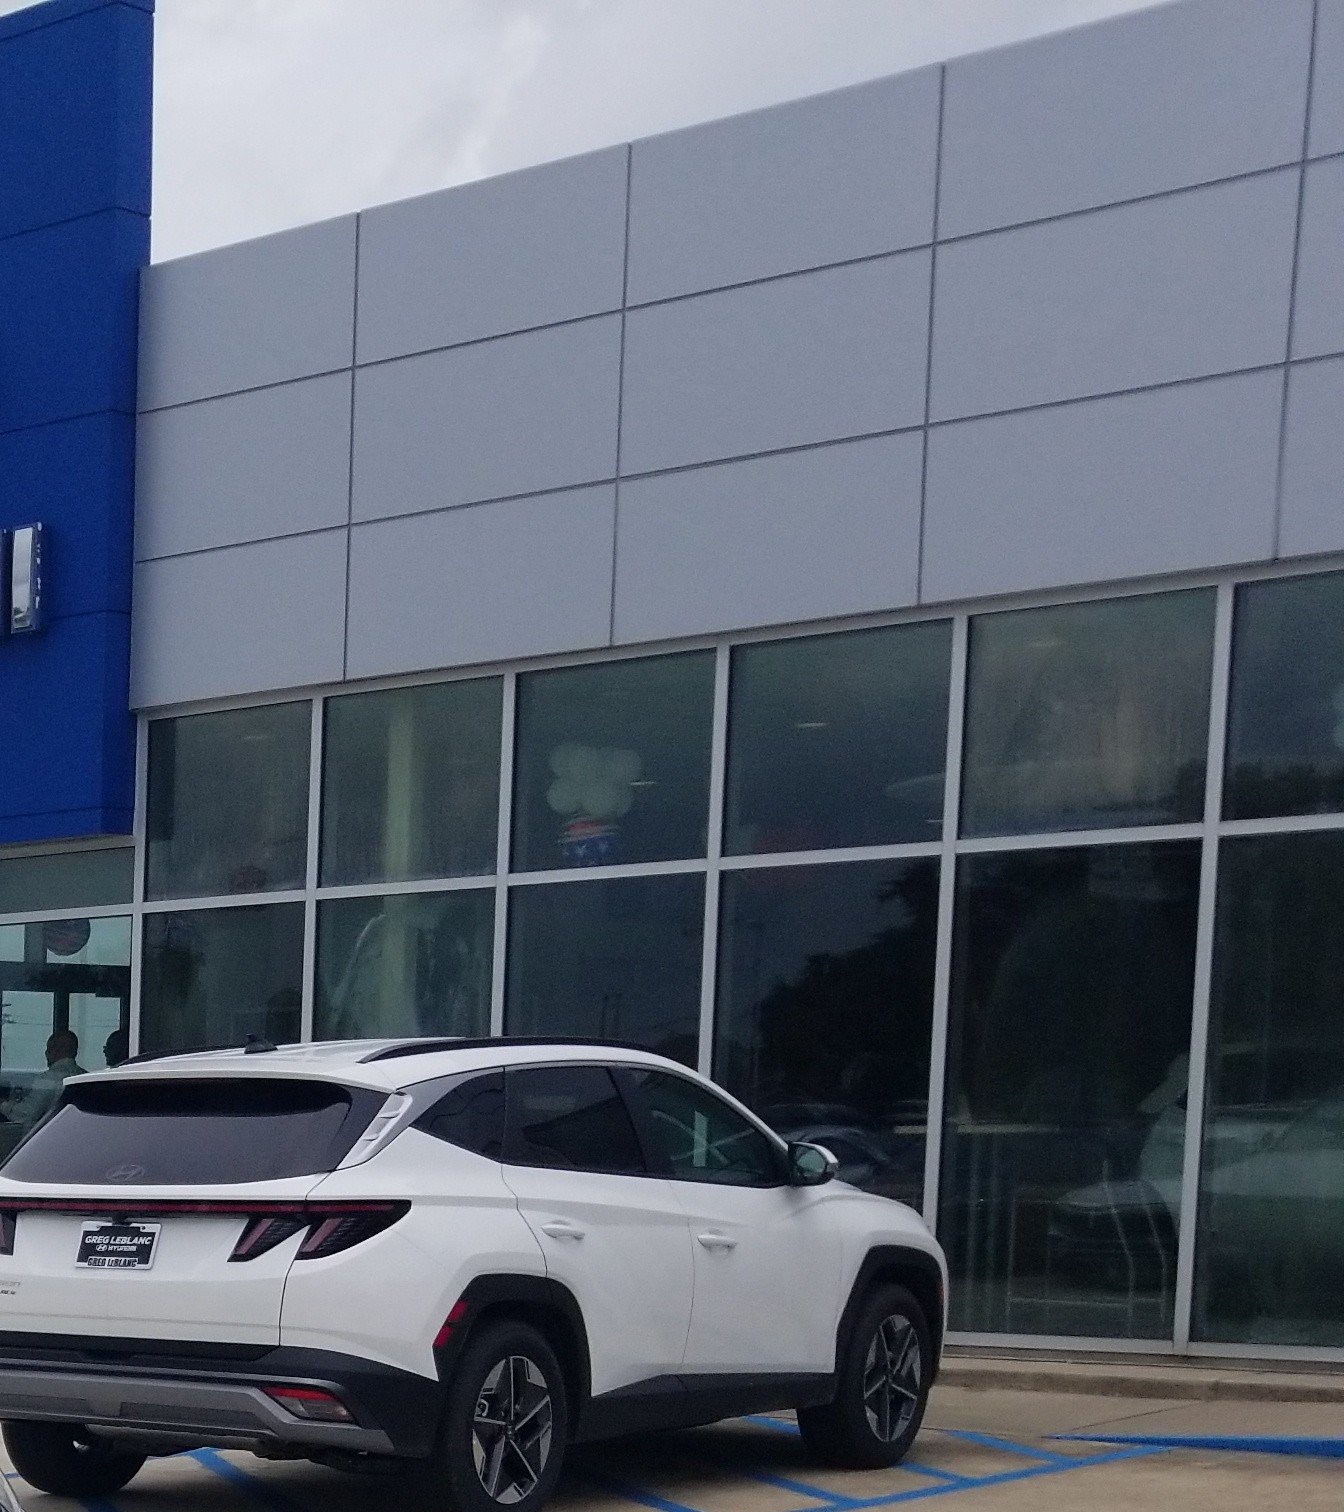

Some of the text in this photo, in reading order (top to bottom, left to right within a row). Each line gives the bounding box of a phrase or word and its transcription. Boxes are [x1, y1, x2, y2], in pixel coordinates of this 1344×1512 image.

[85, 1235, 152, 1245] GREG LEBLANC
[88, 1257, 107, 1267] GREG
